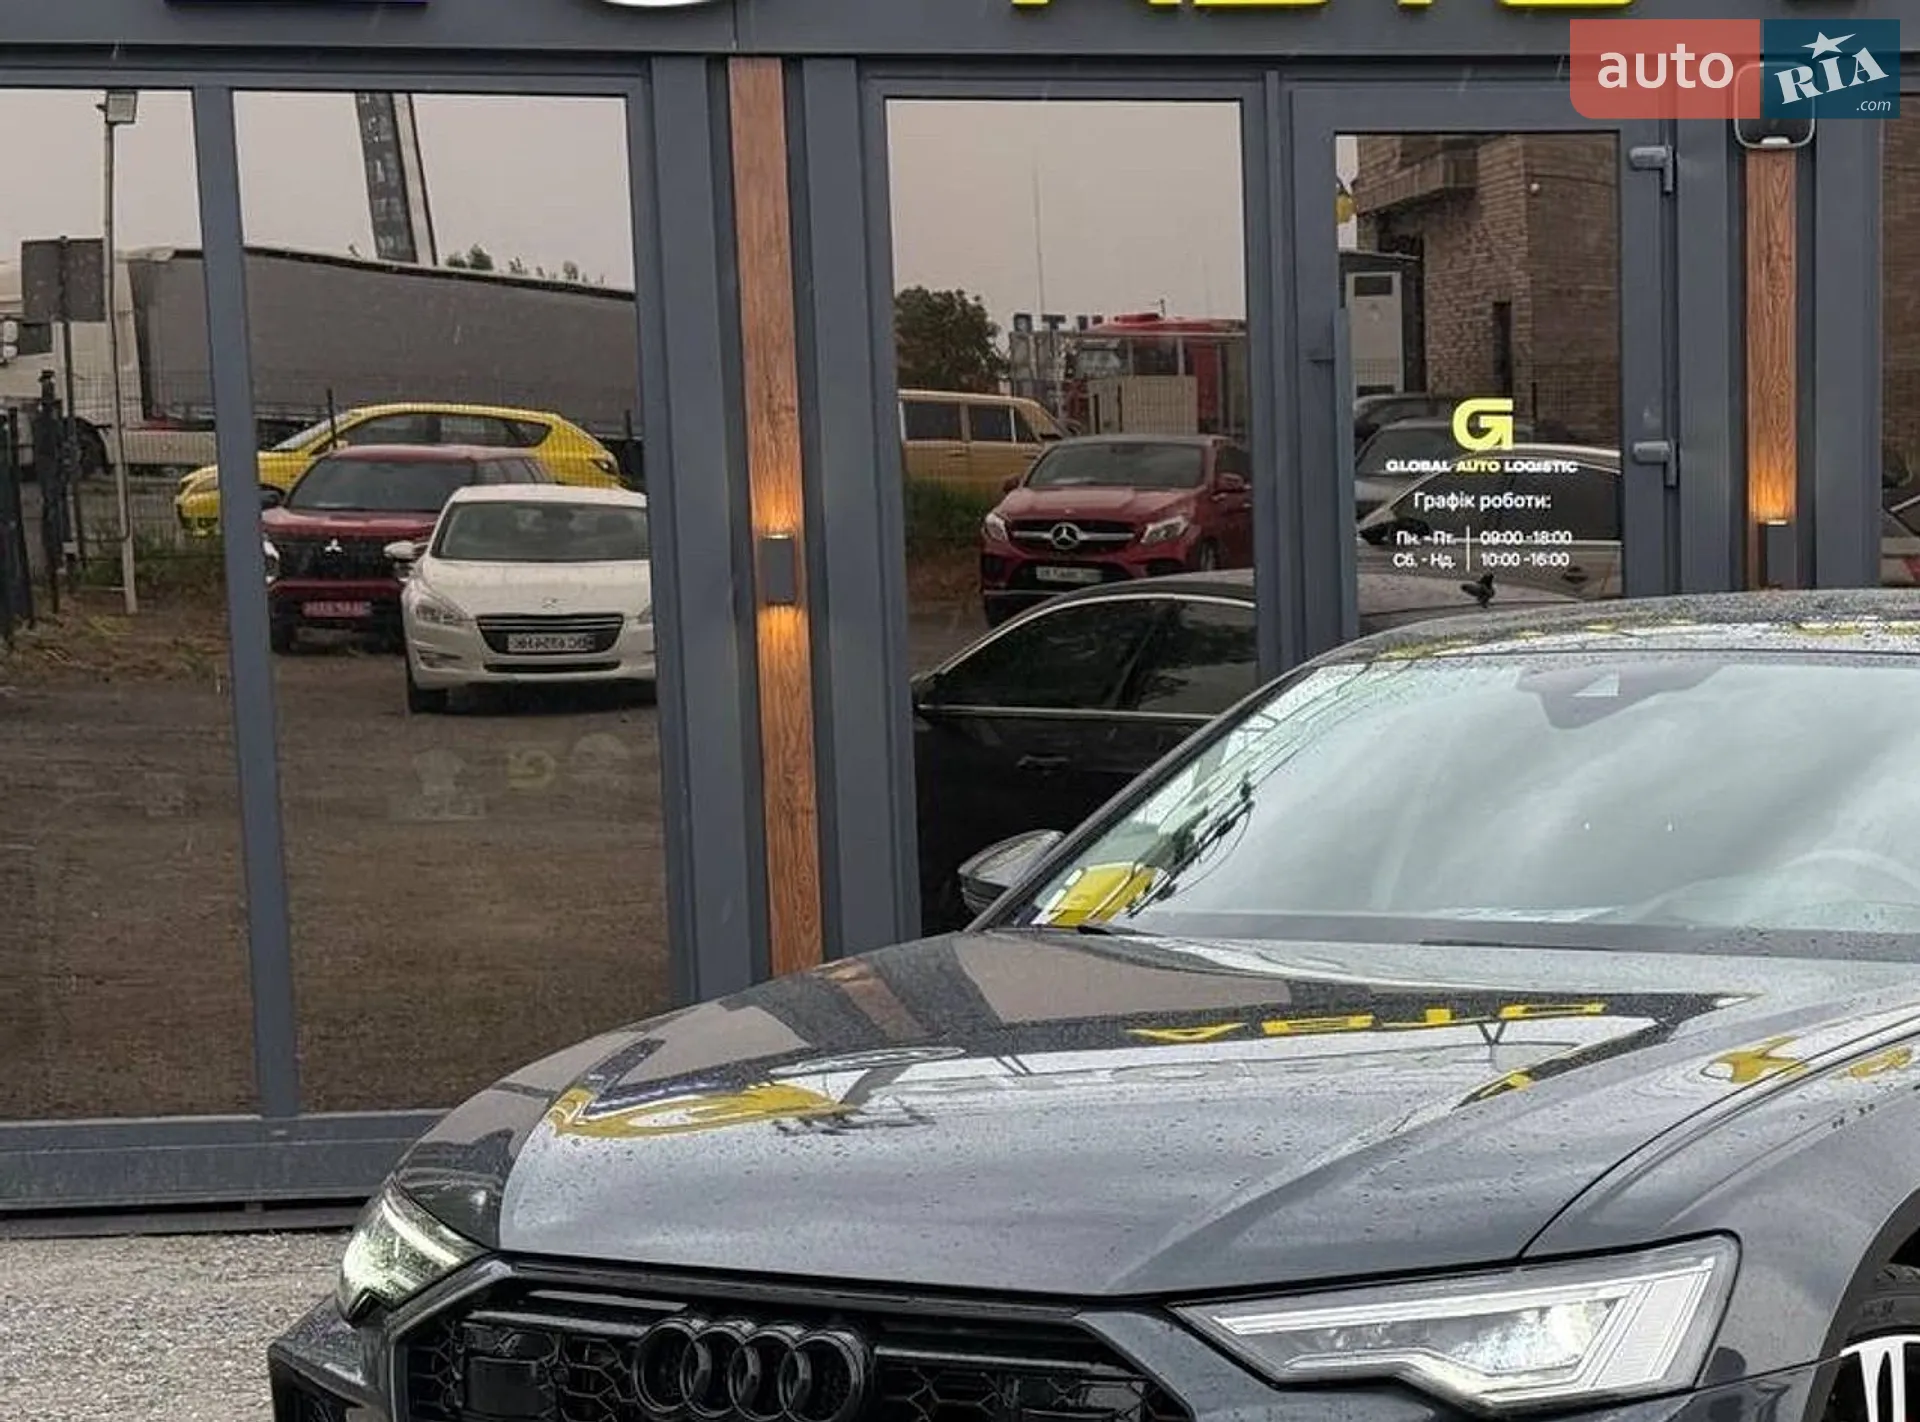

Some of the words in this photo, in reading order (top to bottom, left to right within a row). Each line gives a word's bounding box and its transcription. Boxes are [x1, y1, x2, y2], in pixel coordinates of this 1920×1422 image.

[1386, 460, 1450, 473] GLOBAL
[1456, 460, 1501, 473] AUTO
[1504, 460, 1578, 473] LOGISTIC
[1414, 492, 1475, 511] Графік
[1480, 492, 1551, 511] роботи:
